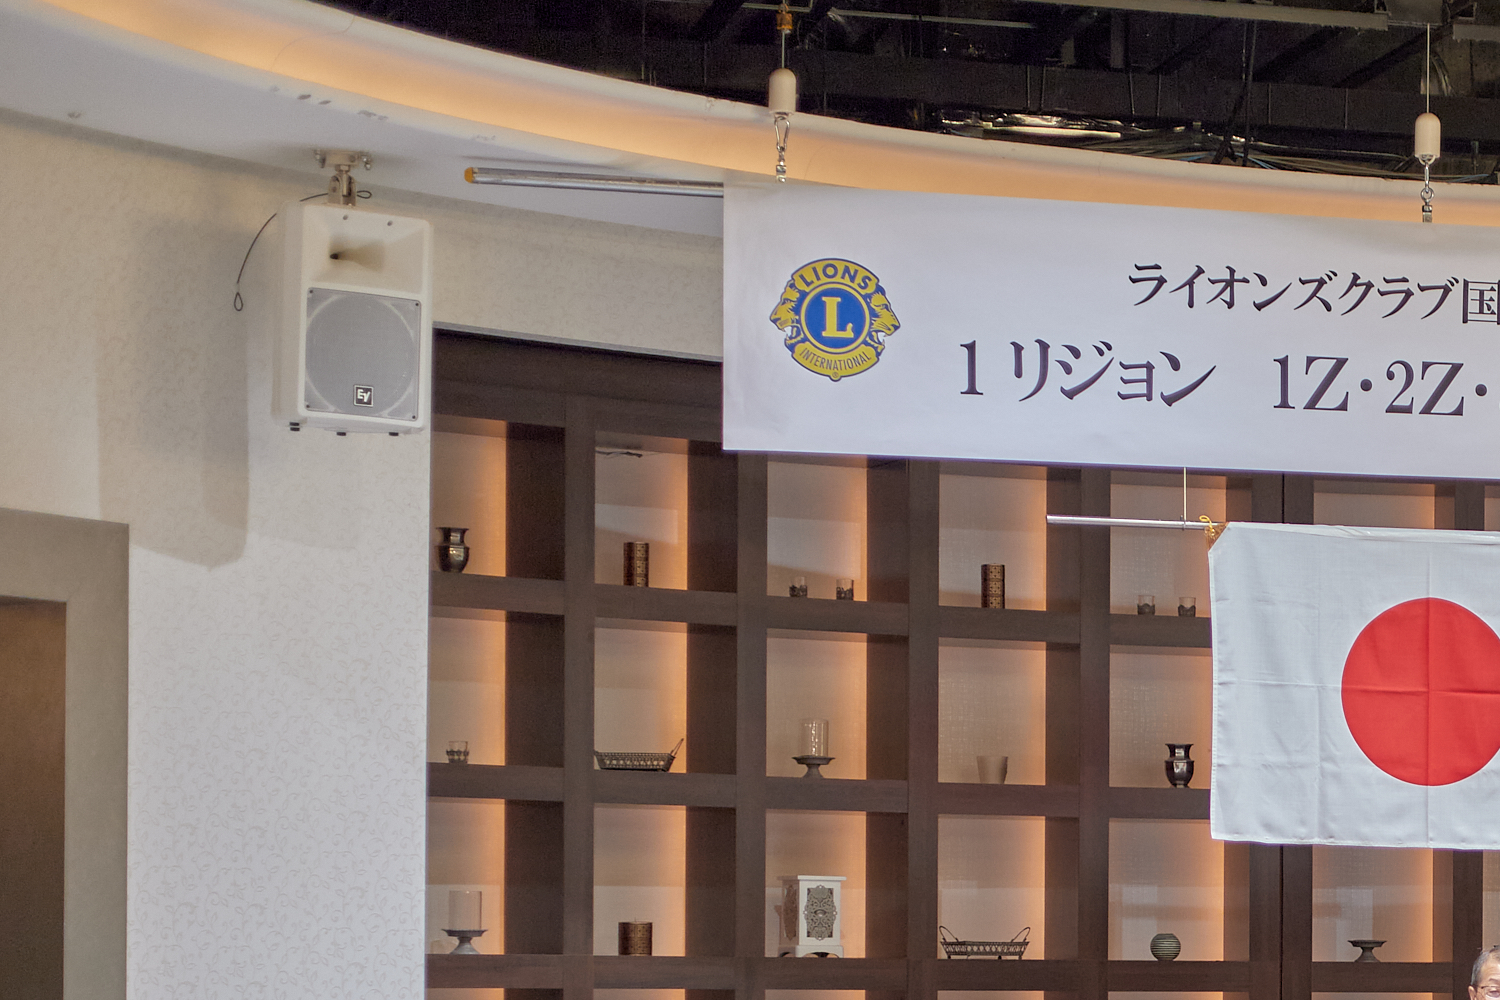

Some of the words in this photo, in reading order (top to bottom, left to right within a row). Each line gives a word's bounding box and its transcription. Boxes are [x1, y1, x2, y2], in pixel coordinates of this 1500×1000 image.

[799, 263, 872, 290] LIONS
[822, 297, 854, 337] L
[799, 347, 872, 371] INTERNATIONAL
